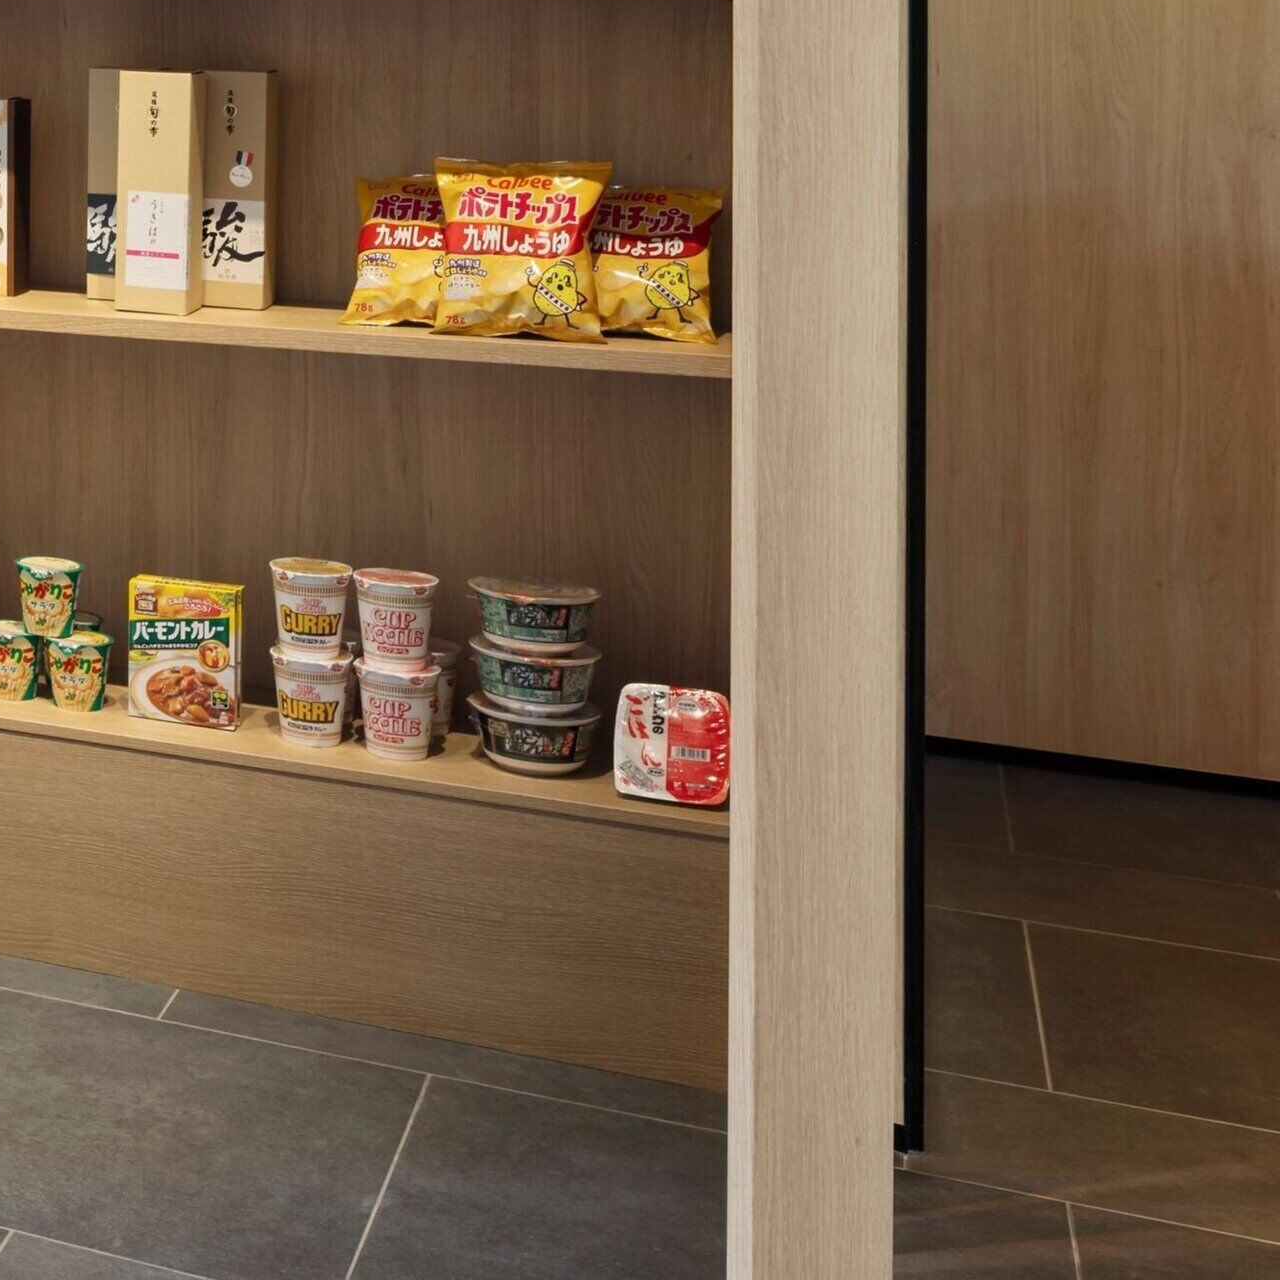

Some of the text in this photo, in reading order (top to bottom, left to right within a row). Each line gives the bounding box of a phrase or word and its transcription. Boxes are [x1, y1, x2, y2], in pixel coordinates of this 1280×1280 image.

[487, 177, 553, 191] Calbee
[372, 194, 444, 221] ポテトチ
[458, 186, 579, 225] ポテトチップス
[596, 202, 693, 234] テトチップス
[375, 224, 444, 248] 九州しょ
[462, 224, 570, 255] 九州しょうゆ
[593, 231, 684, 257] 州しょうゆ
[354, 303, 373, 313] 78g
[538, 285, 570, 312] POTATO
[446, 315, 466, 325] 78g
[133, 620, 225, 640] バーモントカレー
[280, 605, 342, 636] CURRY
[371, 607, 417, 629] CUP
[362, 624, 424, 647] NOODLE
[278, 689, 339, 724] CURRY
[368, 695, 412, 718] CUP
[363, 712, 421, 737] NOODLE
